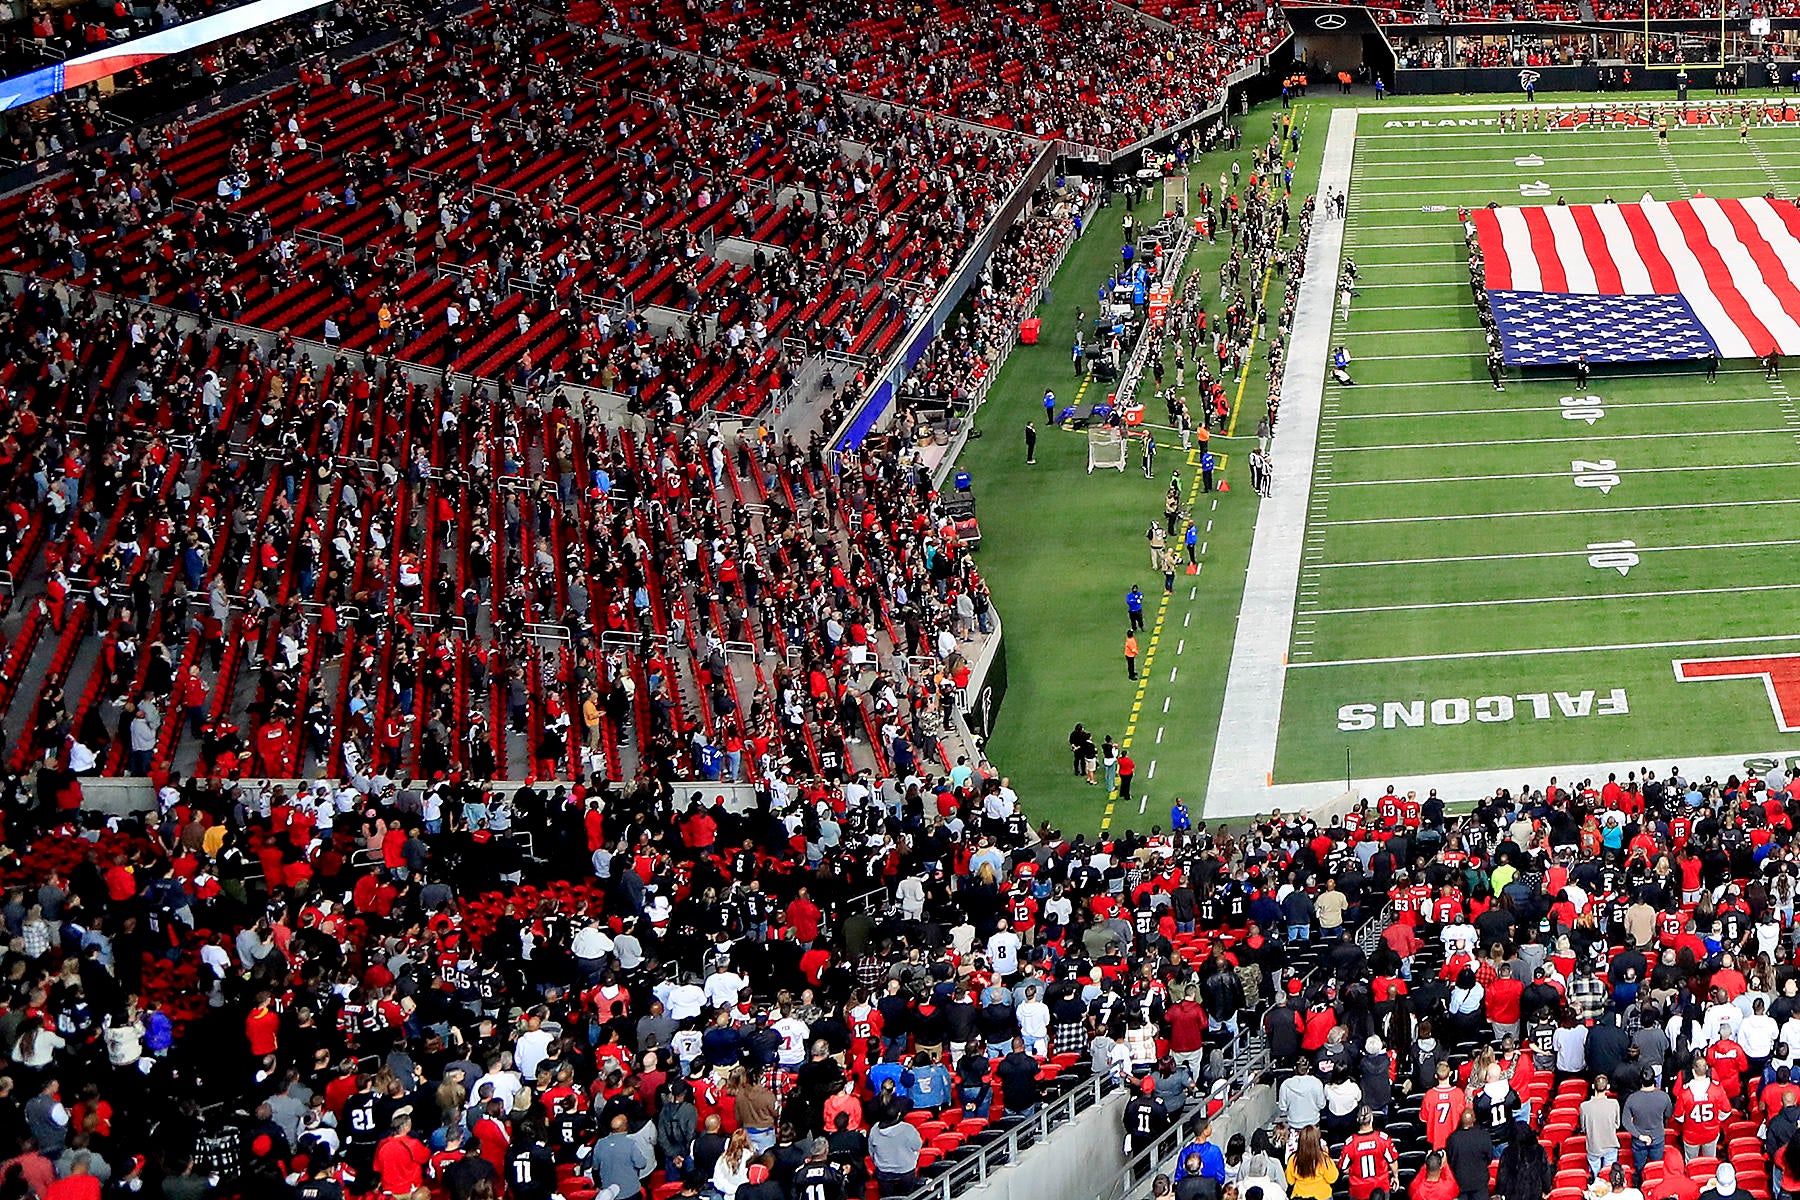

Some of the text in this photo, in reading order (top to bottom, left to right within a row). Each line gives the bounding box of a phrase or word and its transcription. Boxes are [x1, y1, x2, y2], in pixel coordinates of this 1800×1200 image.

[1559, 395, 1605, 420] 30
[1571, 459, 1621, 488] 20
[1586, 540, 1640, 568] 10
[1336, 688, 1630, 732] FALCONS
[1382, 805, 1395, 816] 13
[1406, 808, 1416, 818] 12
[1346, 821, 1356, 832] 88
[1675, 827, 1684, 838] 12
[1079, 876, 1088, 889] 7
[1603, 878, 1612, 891] 5
[1202, 906, 1213, 920] 11
[1232, 902, 1243, 914] 11
[1394, 899, 1409, 912] 63
[1013, 907, 1029, 921] 12
[1440, 909, 1449, 923] 5
[1136, 918, 1151, 934] 21
[1662, 920, 1680, 935] 12
[1727, 923, 1738, 939] 8
[997, 946, 1006, 958] 8
[479, 983, 493, 997] 13
[1099, 1008, 1111, 1025] 7
[853, 1023, 871, 1038] 12
[684, 1042, 692, 1051] 7
[1536, 1036, 1553, 1050] 12
[352, 1108, 375, 1131] 21
[1436, 1102, 1450, 1124] 7
[1490, 1104, 1507, 1127] 11
[1690, 1103, 1714, 1123] 45
[1137, 1114, 1150, 1133] 11
[513, 1160, 532, 1183] 11
[1360, 1154, 1376, 1178] 11
